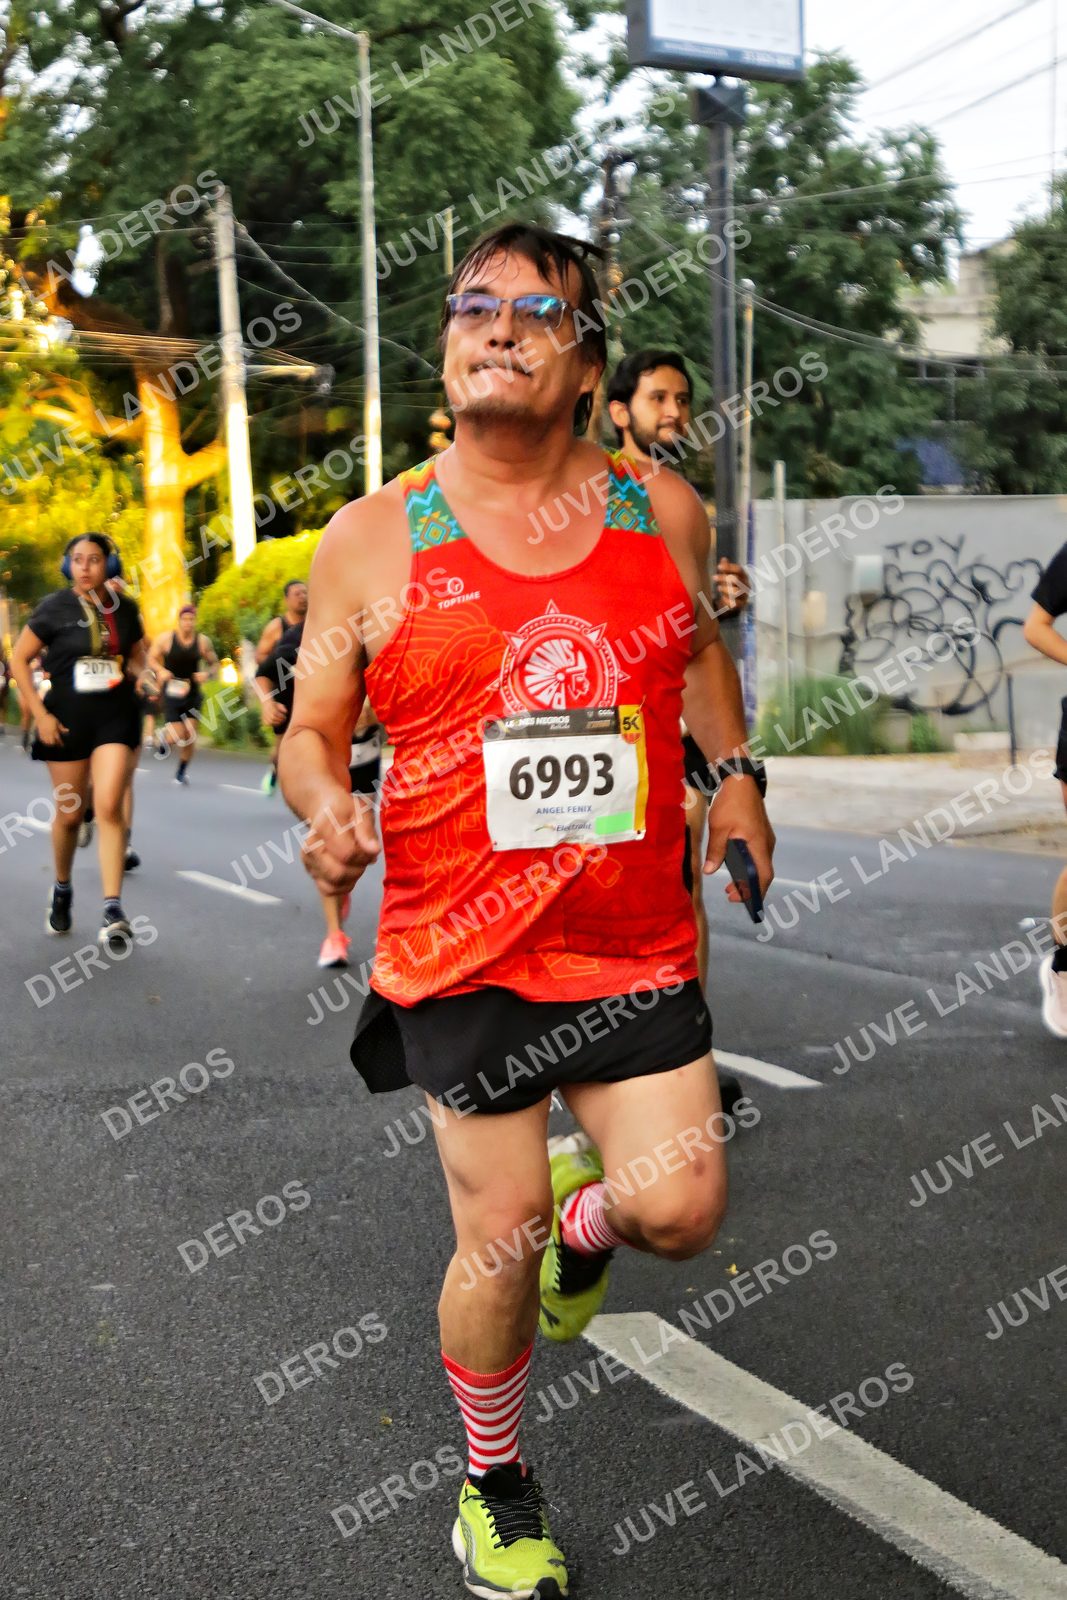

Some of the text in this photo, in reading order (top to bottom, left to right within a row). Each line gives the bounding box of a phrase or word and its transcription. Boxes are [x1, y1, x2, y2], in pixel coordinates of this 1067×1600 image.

[884, 534, 965, 565] TOY
[437, 590, 481, 610] TOPTIME
[622, 716, 640, 730] 5K
[509, 752, 614, 800] 6993
[536, 805, 592, 814] ANGEL FENIX
